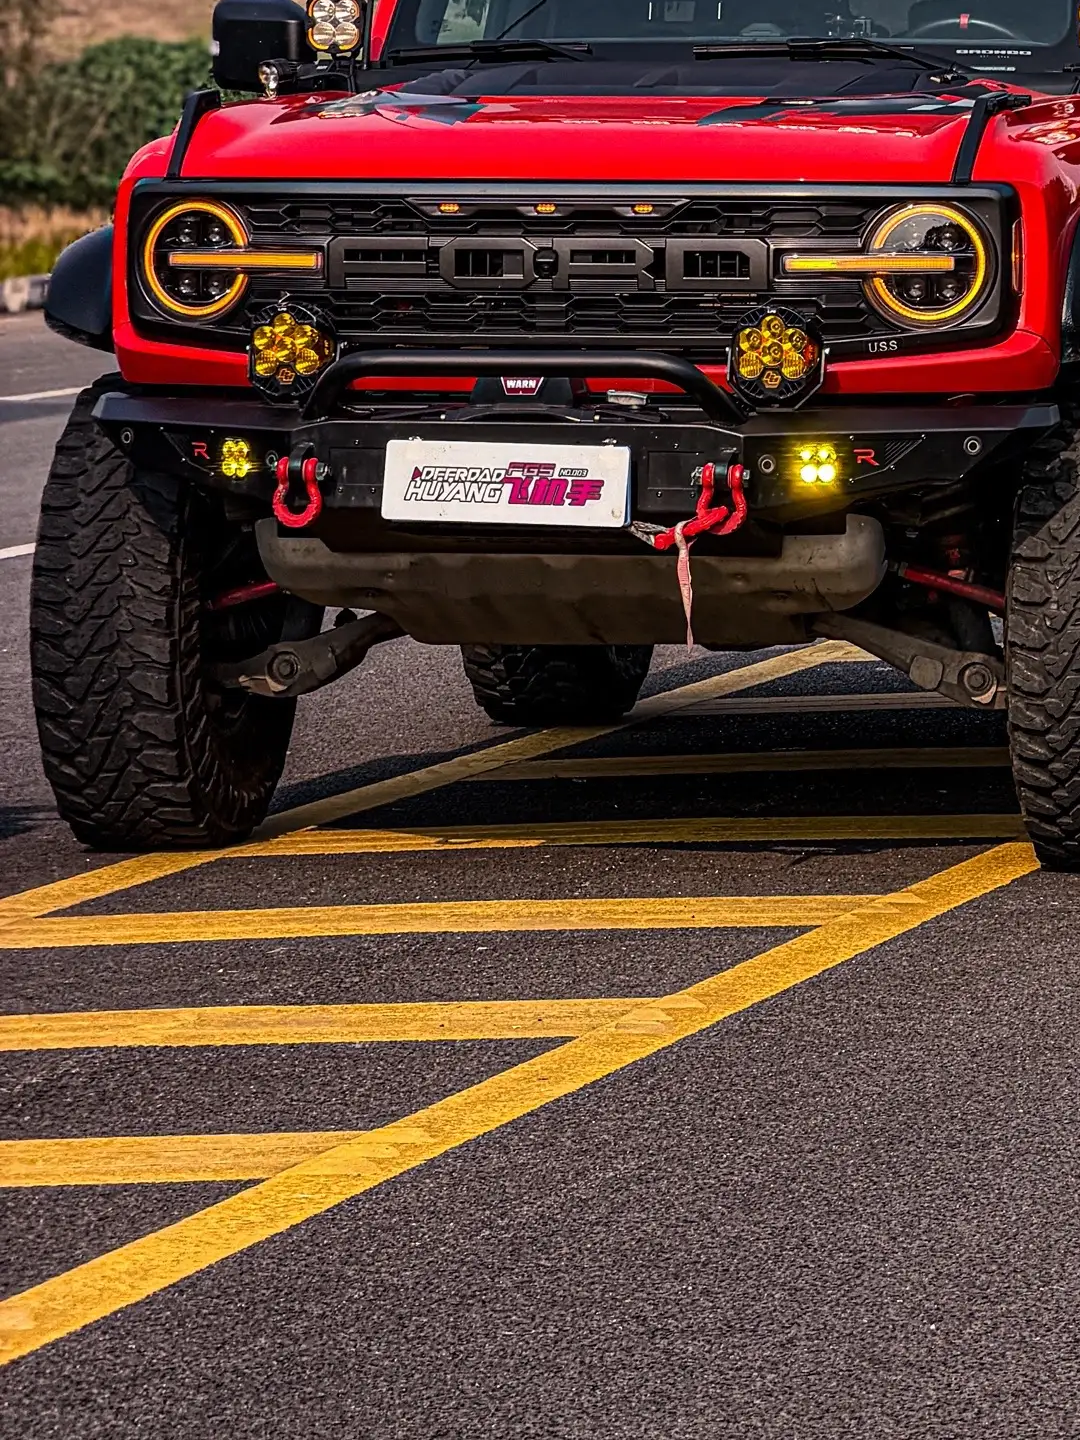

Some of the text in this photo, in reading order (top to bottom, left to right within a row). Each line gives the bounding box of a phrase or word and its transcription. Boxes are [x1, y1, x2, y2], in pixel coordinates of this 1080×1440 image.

[328, 237, 770, 291] FORD
[506, 379, 537, 389] WARN
[420, 466, 506, 482] OFFROAD
[404, 480, 503, 503] HUYANG
[503, 476, 605, 507] 飞机手
